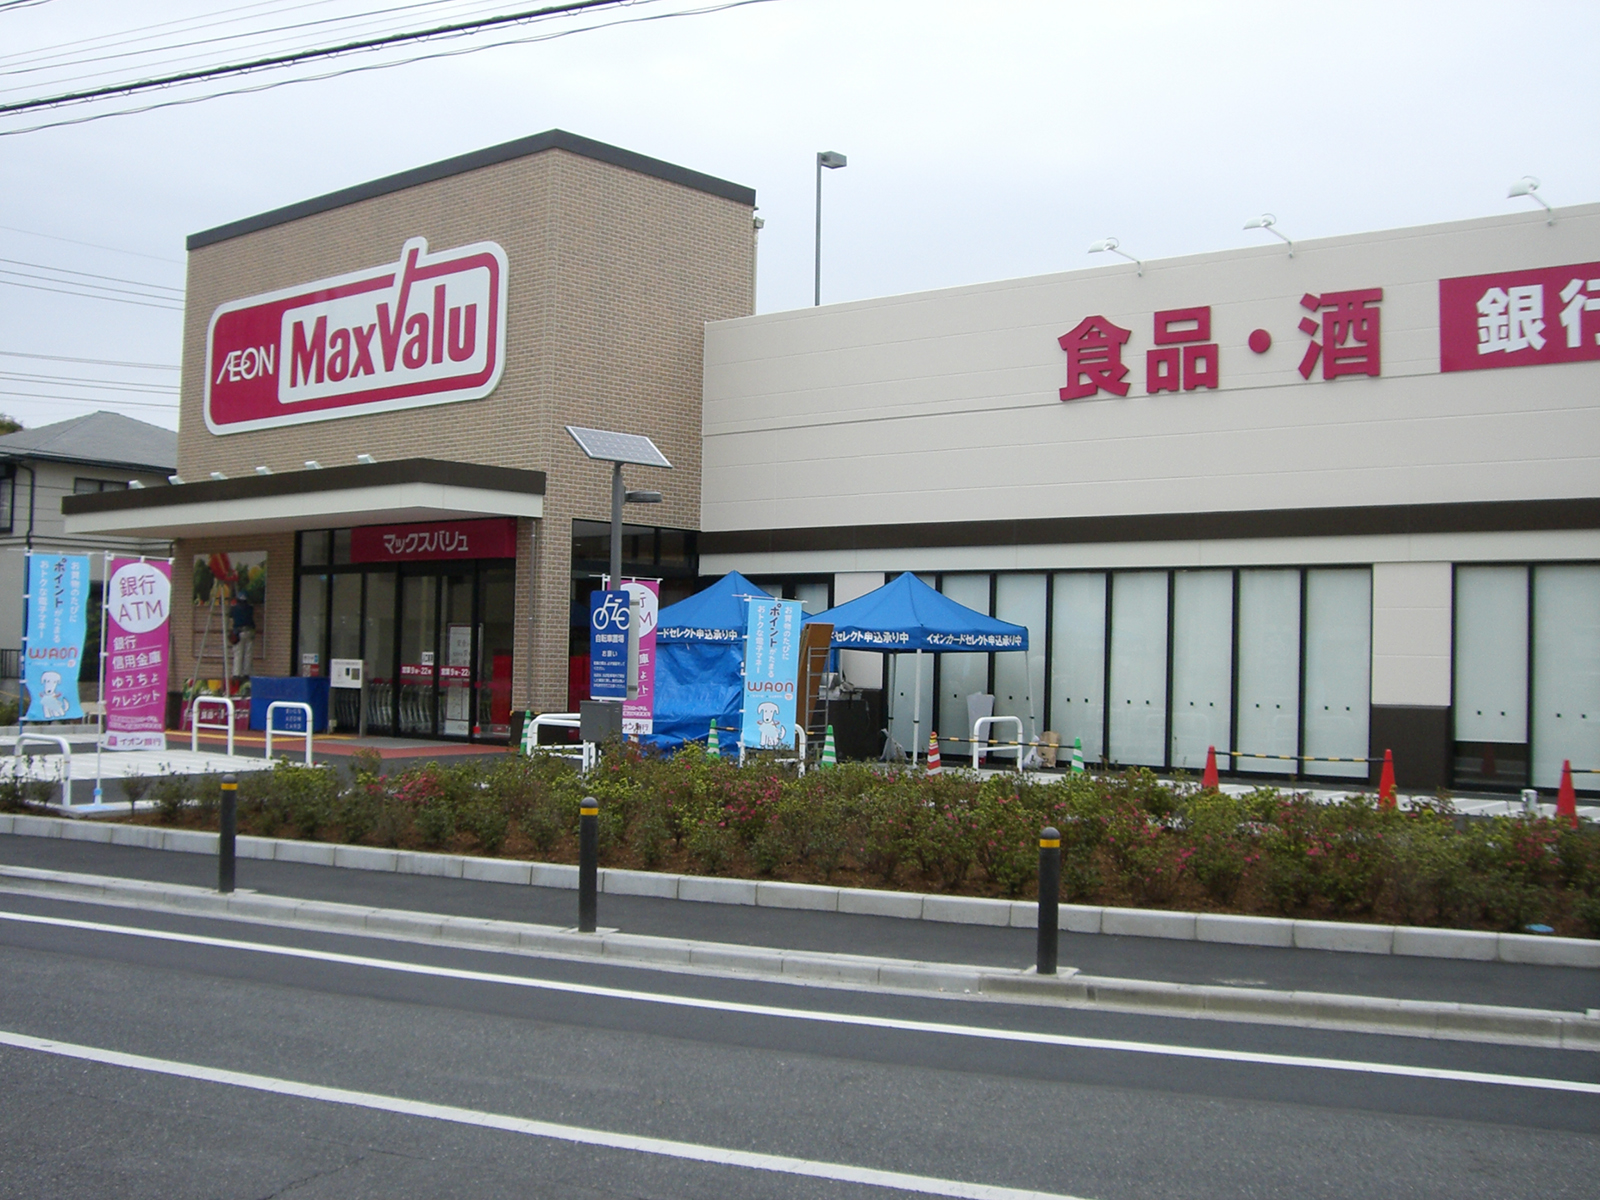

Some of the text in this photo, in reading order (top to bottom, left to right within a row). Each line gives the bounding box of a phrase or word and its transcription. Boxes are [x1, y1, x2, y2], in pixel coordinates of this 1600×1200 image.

[289, 248, 477, 388] MaxValu
[1058, 287, 1383, 401] 食品・酒
[383, 530, 469, 554] マックスバリュ
[119, 574, 156, 598] 銀行
[53, 558, 67, 643] ポイントがたまる
[119, 599, 163, 622] ATM
[113, 634, 136, 652] 銀行
[755, 605, 766, 674] おトクな電子マネー
[768, 603, 782, 678] ポイントがたまる
[782, 606, 793, 660] お買物のたびに
[926, 633, 1022, 647] イオンカードセレクト申込承り中
[28, 646, 78, 660] WAON
[112, 651, 161, 670] 信用金庫
[112, 673, 159, 688] ゆうちょ
[747, 681, 794, 693] WAON
[111, 689, 161, 708] クレジット
